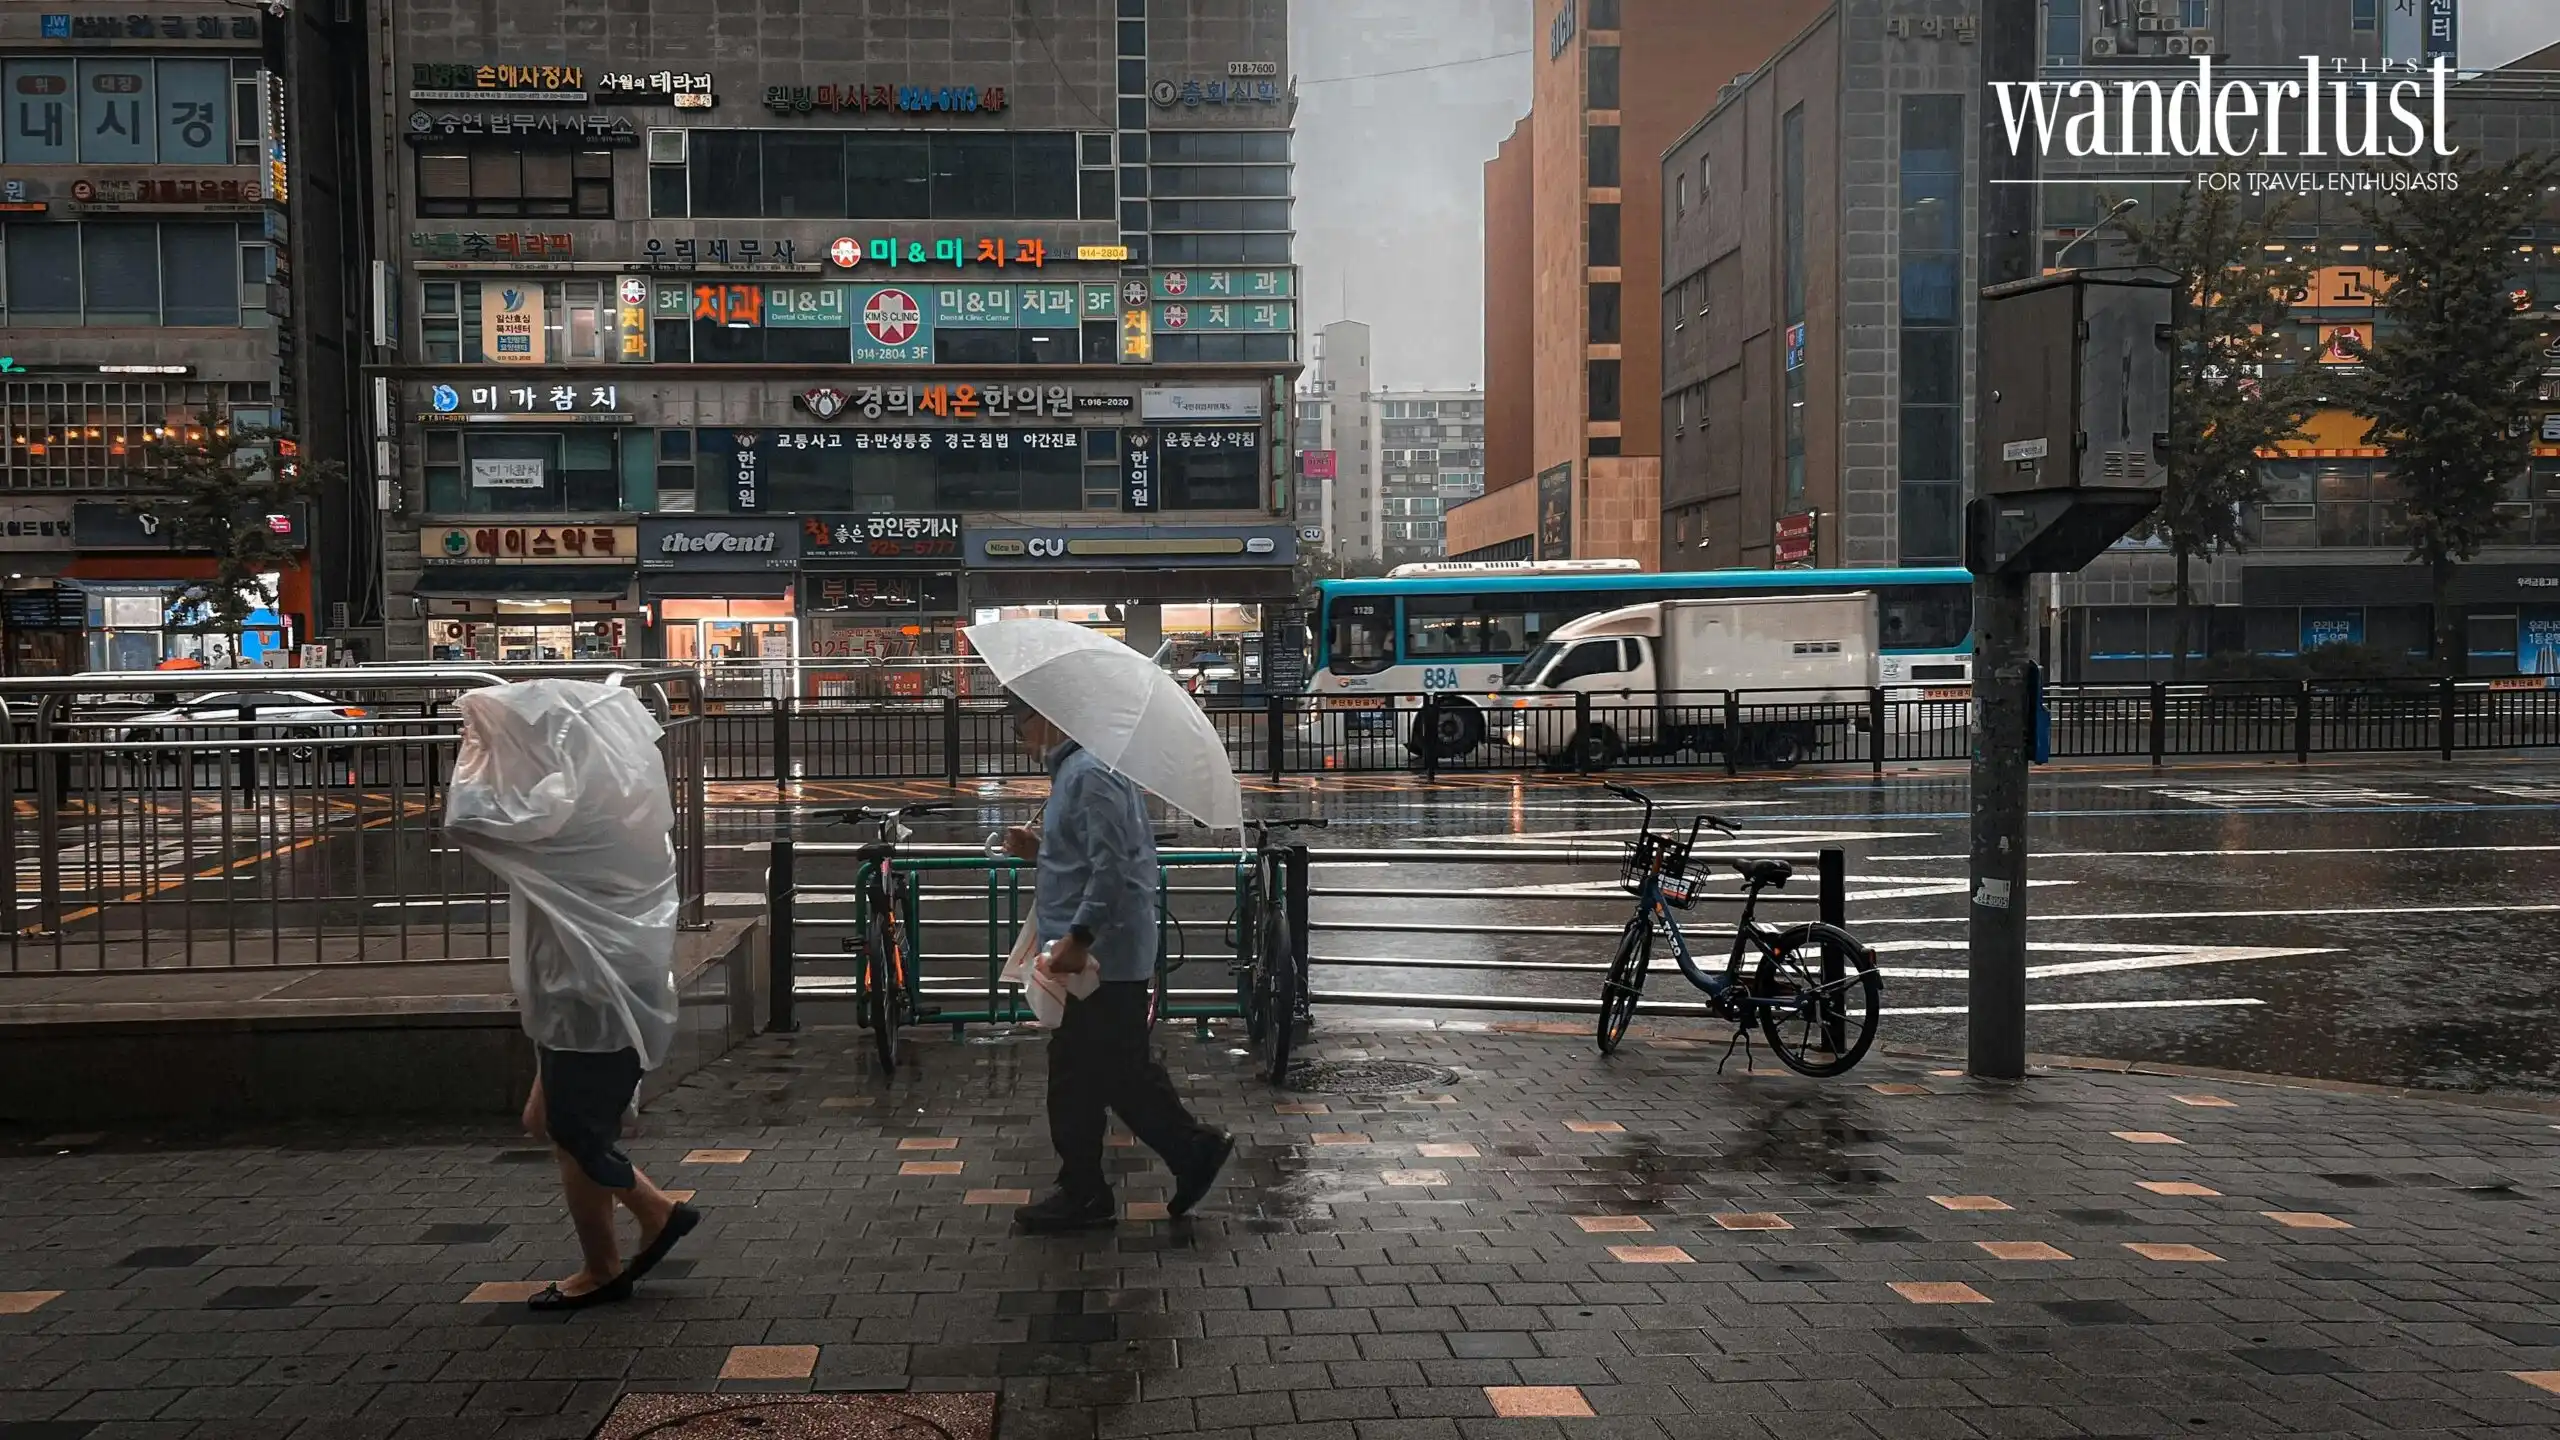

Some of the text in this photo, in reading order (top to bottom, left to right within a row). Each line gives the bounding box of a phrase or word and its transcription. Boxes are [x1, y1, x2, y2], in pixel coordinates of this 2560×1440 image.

[47, 15, 66, 27] JW
[476, 63, 584, 91] 손해사정사
[1230, 63, 1275, 74] 918-7600
[599, 70, 712, 94] 사월의 테라피
[818, 83, 896, 115] 마사지
[436, 113, 635, 136] 송연 법무사 사무소
[976, 237, 1048, 269] 치과
[1208, 271, 1278, 295] 치과
[659, 290, 684, 309] 3F
[693, 283, 765, 327] 치과
[1022, 288, 1074, 314] 치과
[1088, 292, 1111, 310] 3F
[865, 311, 919, 321] KIM'S CLINIC
[1208, 304, 1278, 328] 치과
[857, 346, 929, 360] 914-2804 3F
[776, 433, 843, 449] 교통사고
[1023, 433, 1078, 448] 야간진료
[738, 450, 757, 508] 한의원
[1130, 450, 1149, 507] 한의원
[475, 528, 615, 556] 에이스약국
[834, 523, 865, 544] 좋은
[867, 517, 959, 539] 공인중개사
[1304, 530, 1320, 539] CU
[661, 532, 776, 553] theVenti
[1028, 537, 1064, 557] CU
[1423, 667, 1460, 689] 88A
